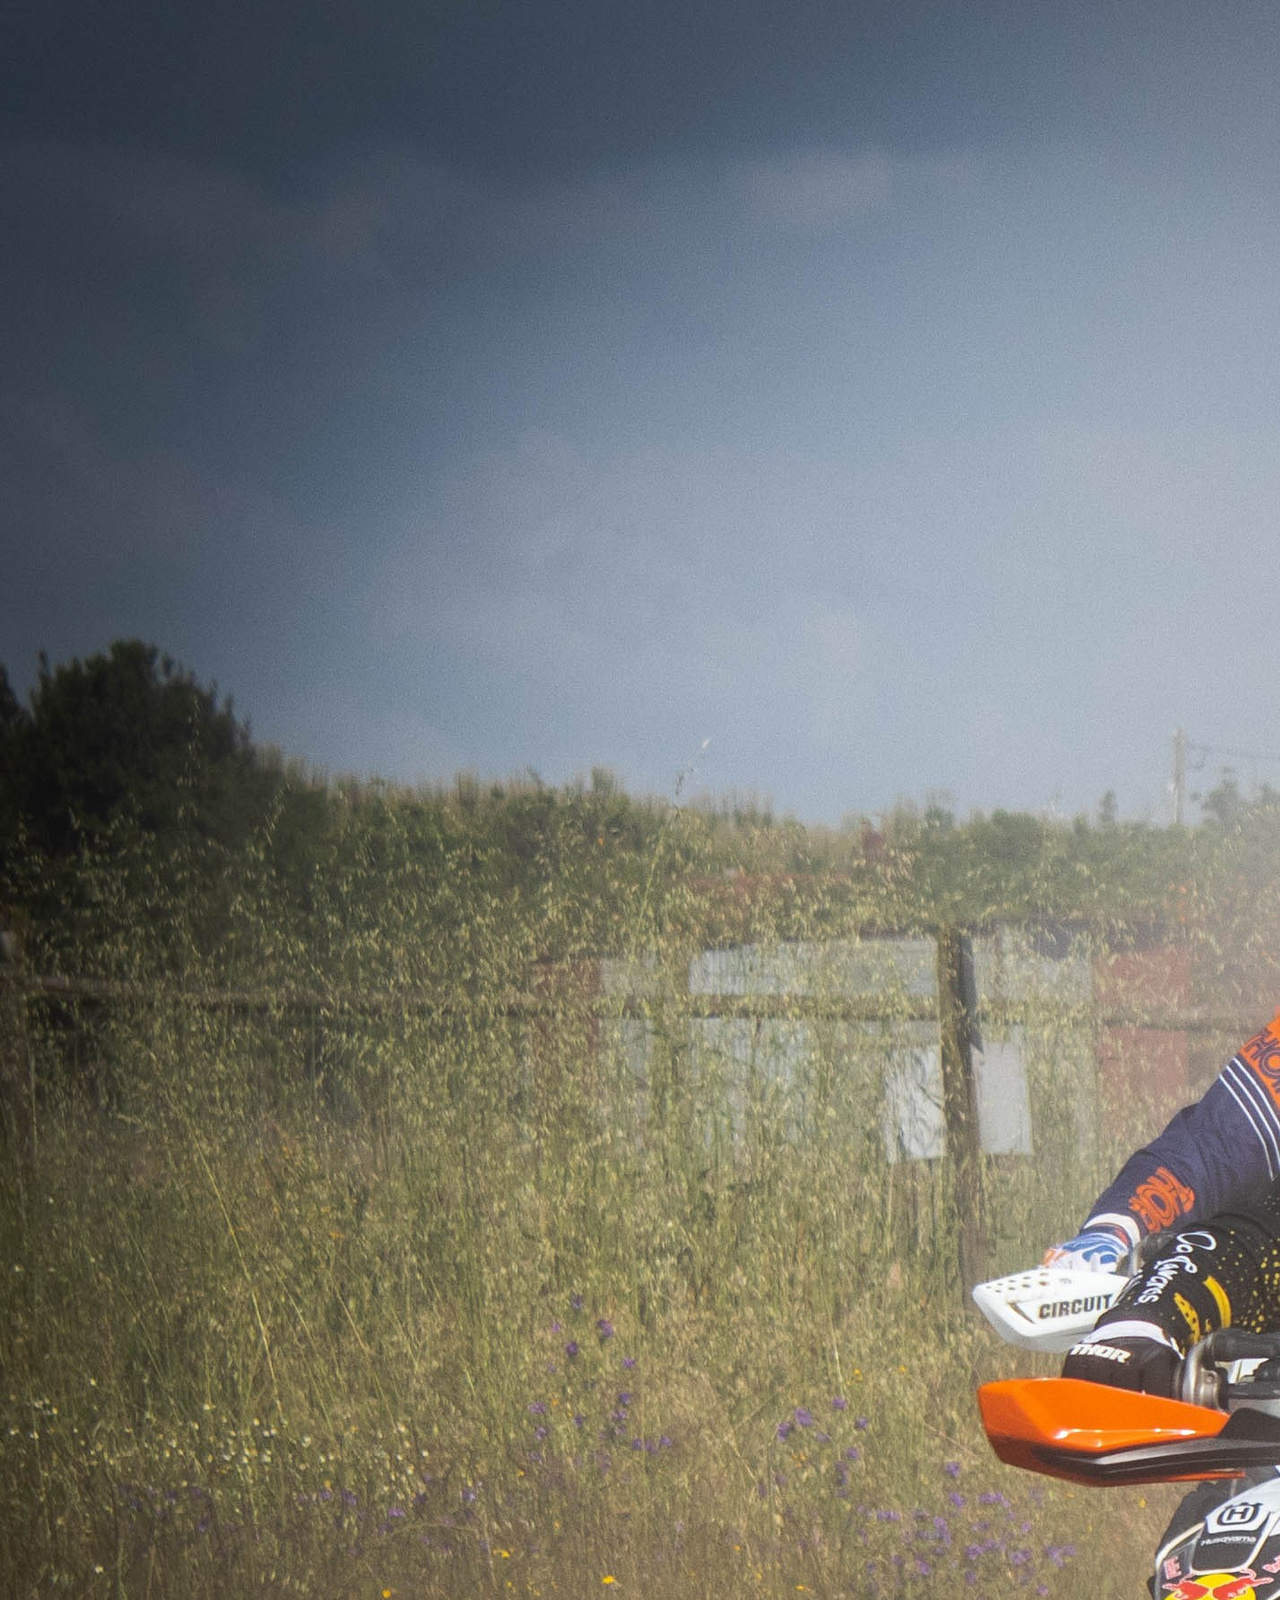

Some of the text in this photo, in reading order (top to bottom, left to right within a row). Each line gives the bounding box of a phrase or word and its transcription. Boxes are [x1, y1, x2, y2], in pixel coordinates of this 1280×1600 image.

[1039, 1293, 1114, 1320] CIRCUIT
[1069, 1343, 1132, 1363] THOR
[1200, 1535, 1257, 1547] Husqvarna
